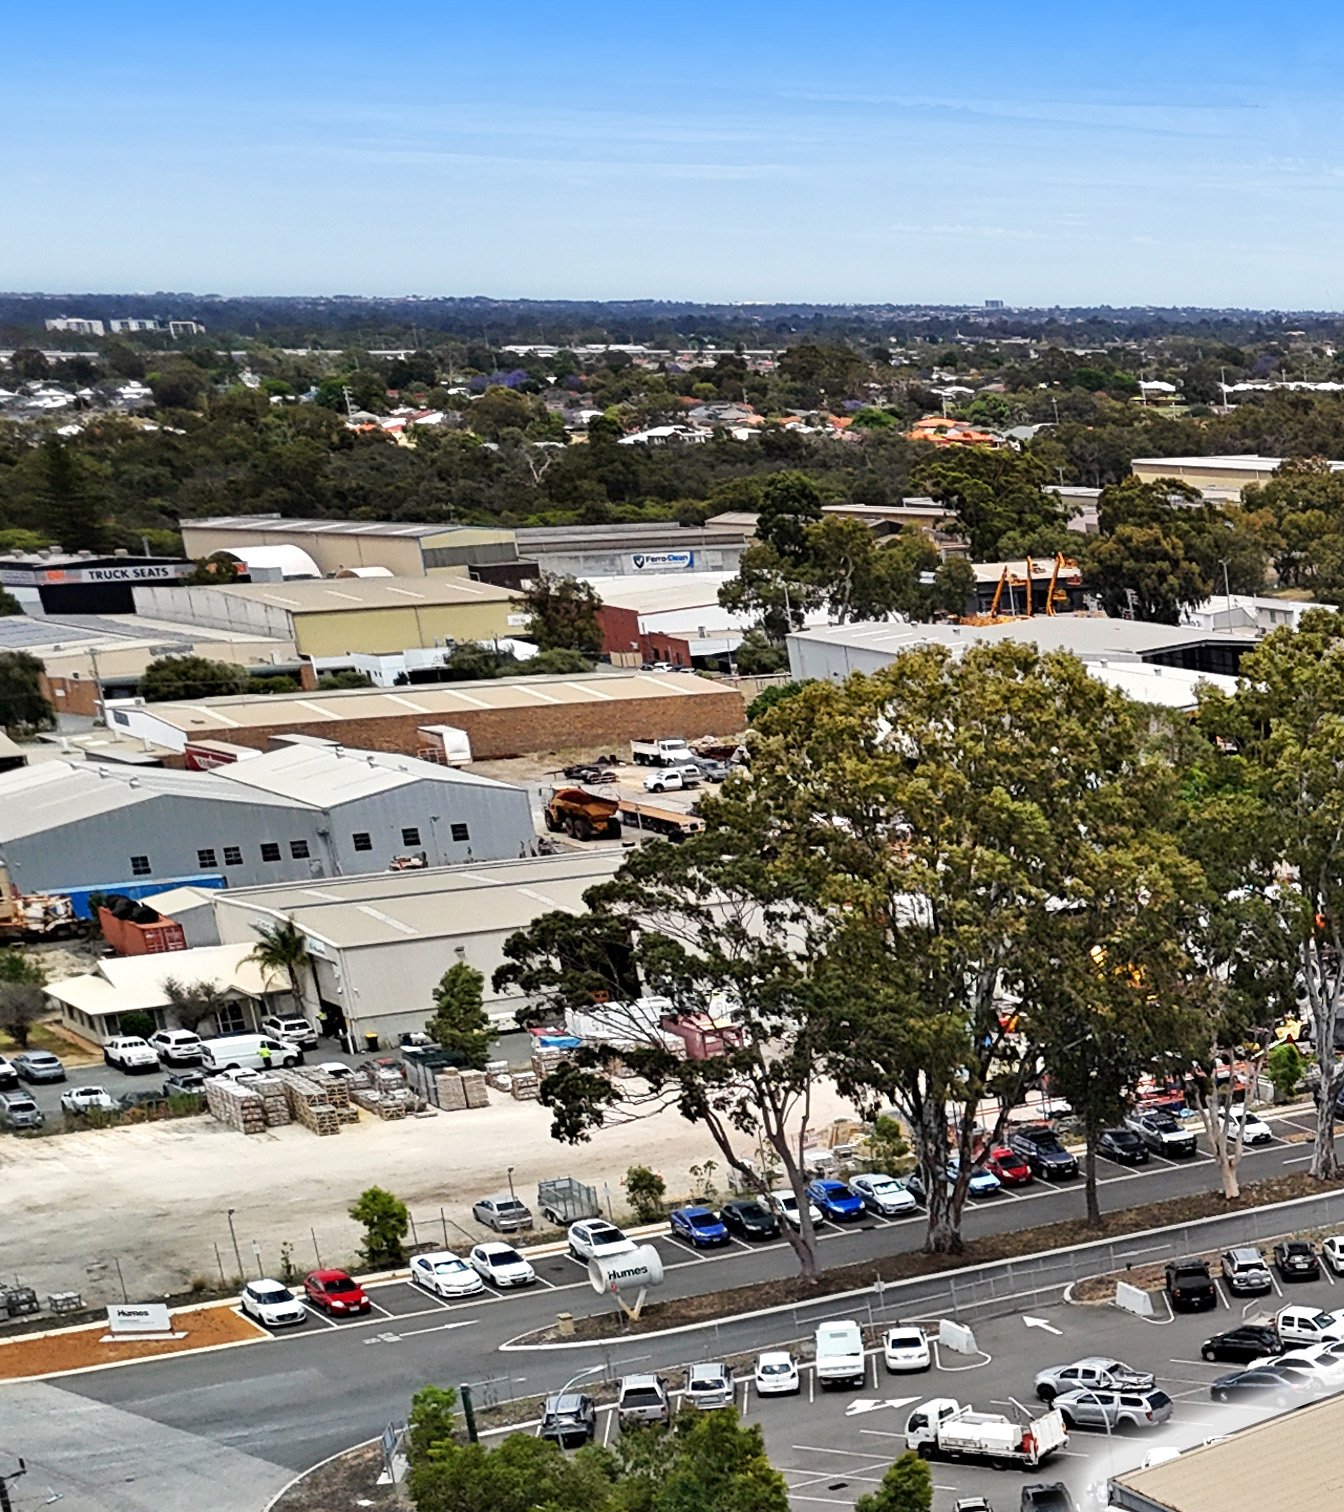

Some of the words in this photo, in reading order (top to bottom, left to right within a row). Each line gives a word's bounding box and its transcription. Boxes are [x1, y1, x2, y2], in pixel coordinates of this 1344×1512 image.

[88, 569, 130, 581] TRUCK
[135, 567, 169, 579] SEATS
[608, 1265, 648, 1280] Humes
